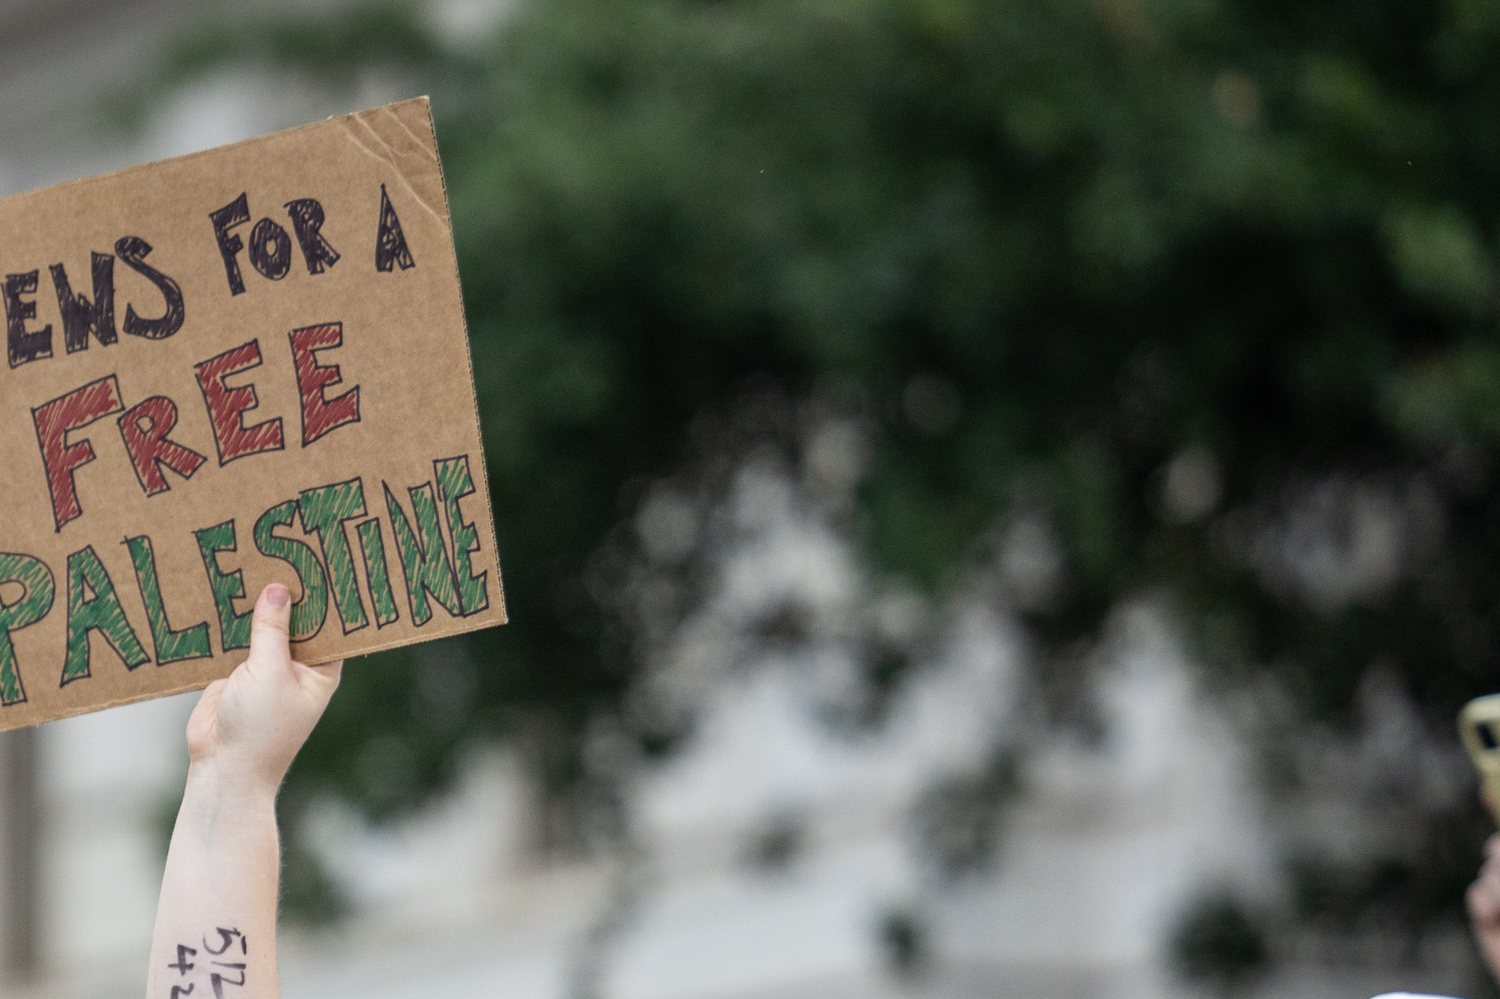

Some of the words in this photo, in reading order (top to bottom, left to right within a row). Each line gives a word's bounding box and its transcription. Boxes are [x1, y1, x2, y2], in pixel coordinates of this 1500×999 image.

[209, 191, 341, 297] FOR
[375, 183, 415, 273] A
[30, 321, 361, 533] FREE
